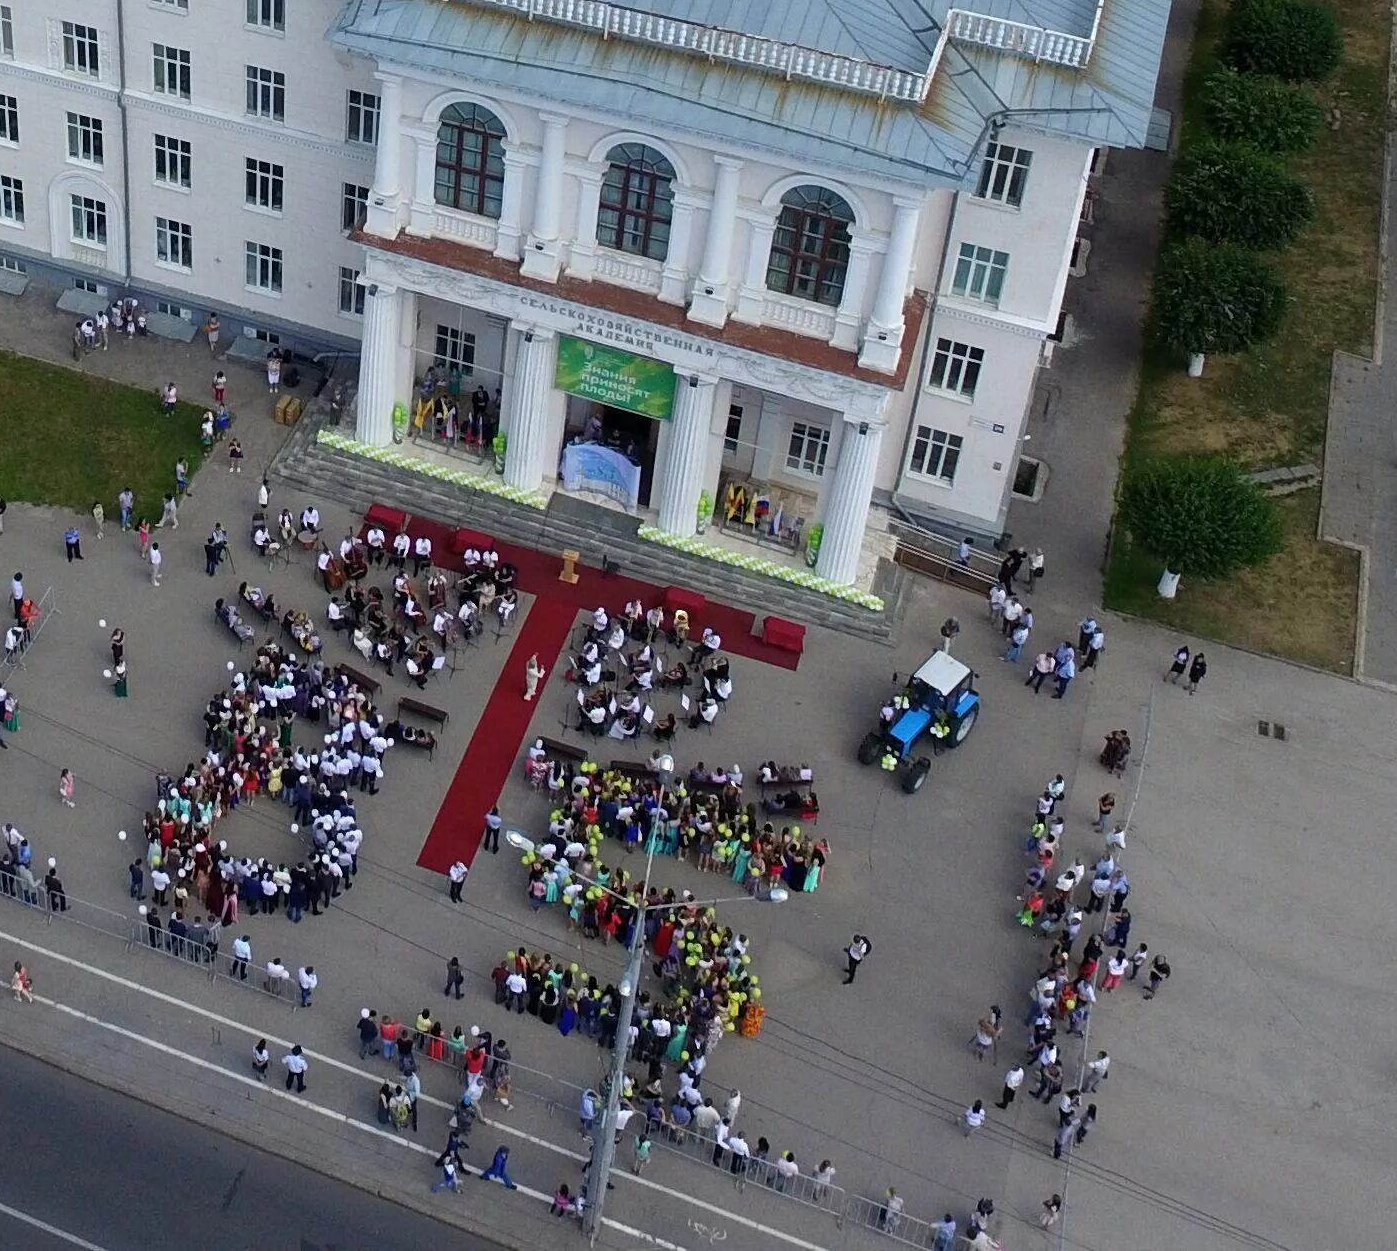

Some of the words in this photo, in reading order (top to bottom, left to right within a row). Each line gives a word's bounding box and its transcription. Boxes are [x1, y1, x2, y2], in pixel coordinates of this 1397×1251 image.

[520, 297, 714, 358] СЕЛЬСКОХОЗЯЙСТВЕННАЯ
[576, 323, 653, 351] АКАДЕМИЯ
[581, 373, 652, 399] приносят
[583, 361, 637, 385] Знания
[580, 383, 631, 404] плоды!
